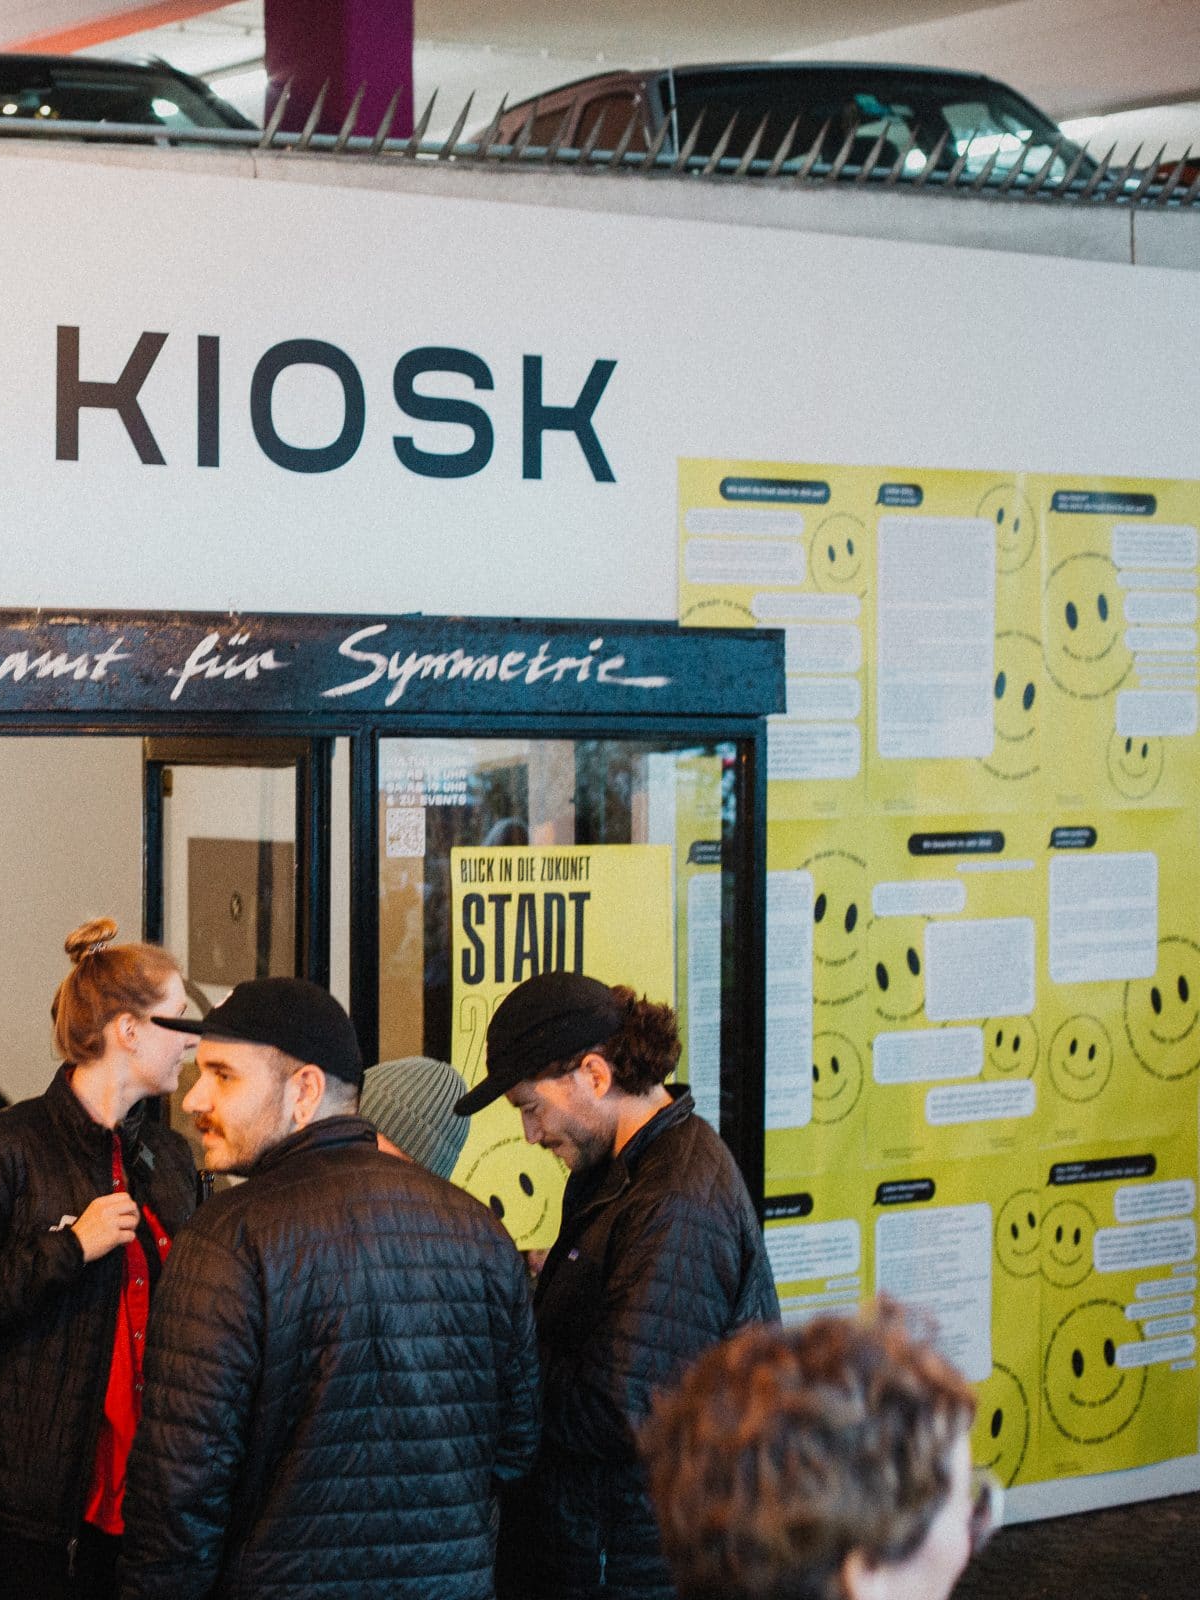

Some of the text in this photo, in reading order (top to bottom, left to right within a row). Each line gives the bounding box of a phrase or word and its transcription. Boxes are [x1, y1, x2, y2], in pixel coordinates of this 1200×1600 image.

[56, 325, 618, 483] KIOSK
[167, 631, 284, 702] für
[321, 623, 669, 707] Symmetrie
[461, 856, 591, 882] BLICK IN DIE ZUKUNFT
[461, 891, 591, 985] STADT
